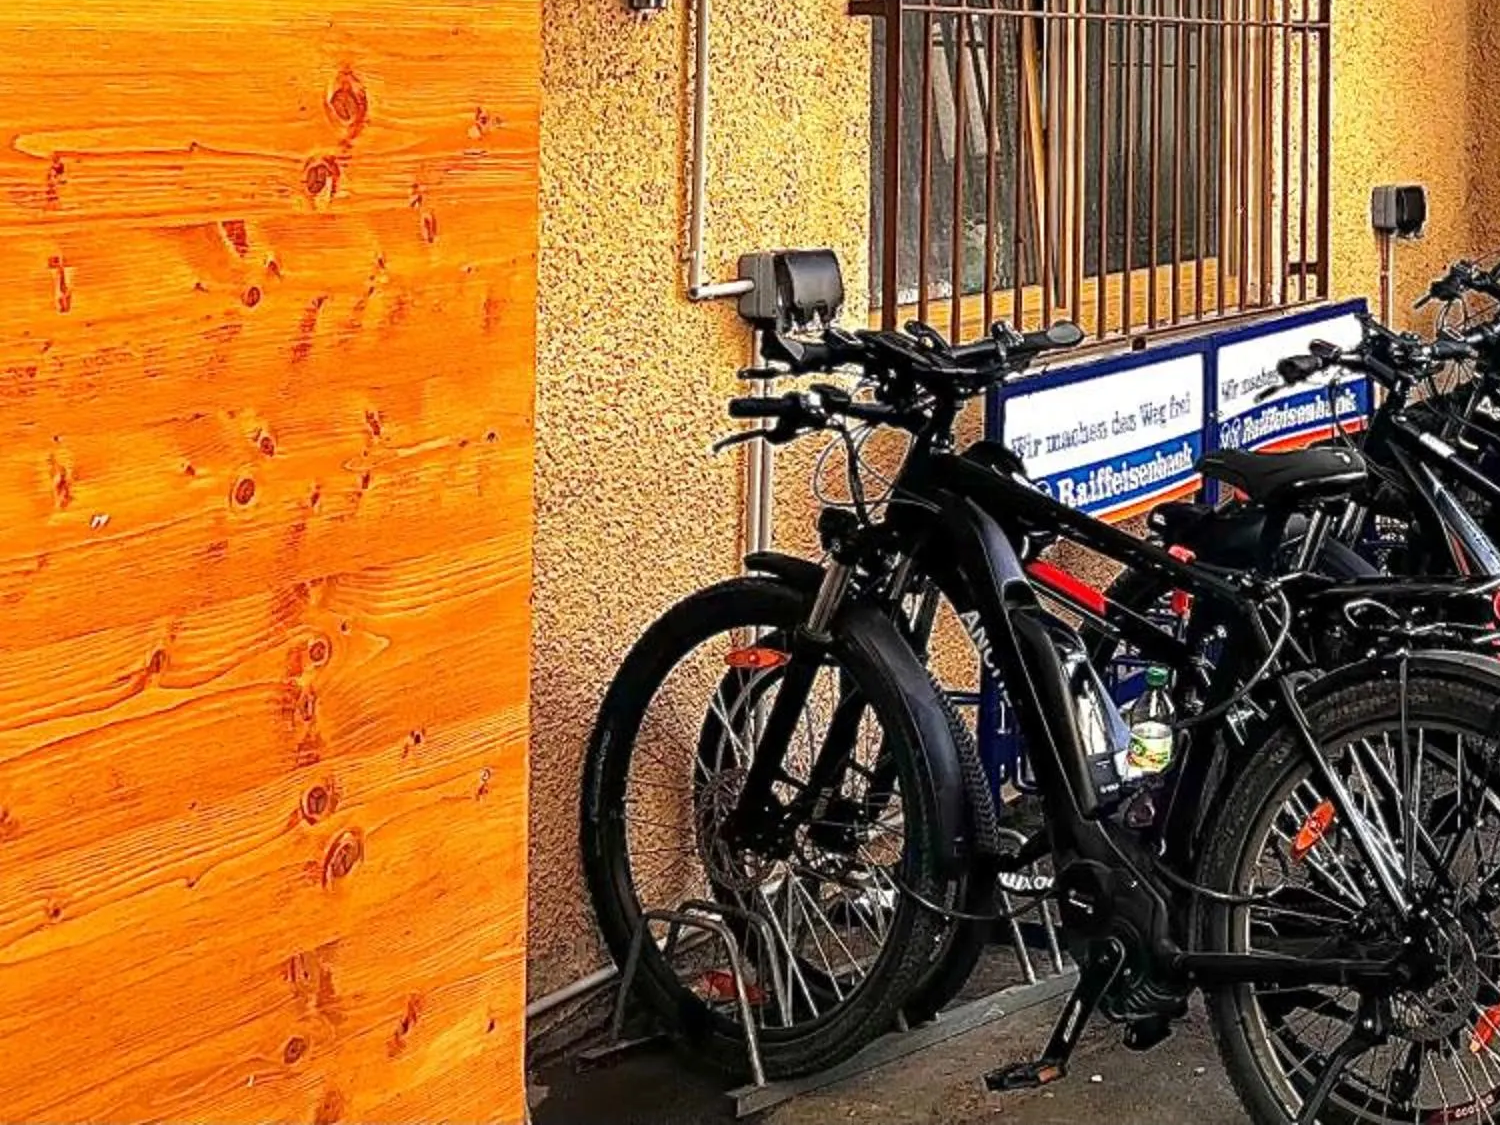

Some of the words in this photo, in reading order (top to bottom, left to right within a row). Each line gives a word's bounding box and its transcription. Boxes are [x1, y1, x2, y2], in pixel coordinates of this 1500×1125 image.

[1011, 432, 1042, 460] Wir
[1045, 421, 1108, 454] machen
[1139, 402, 1167, 427] Weg
[1057, 441, 1193, 507] Raiffeisenbank
